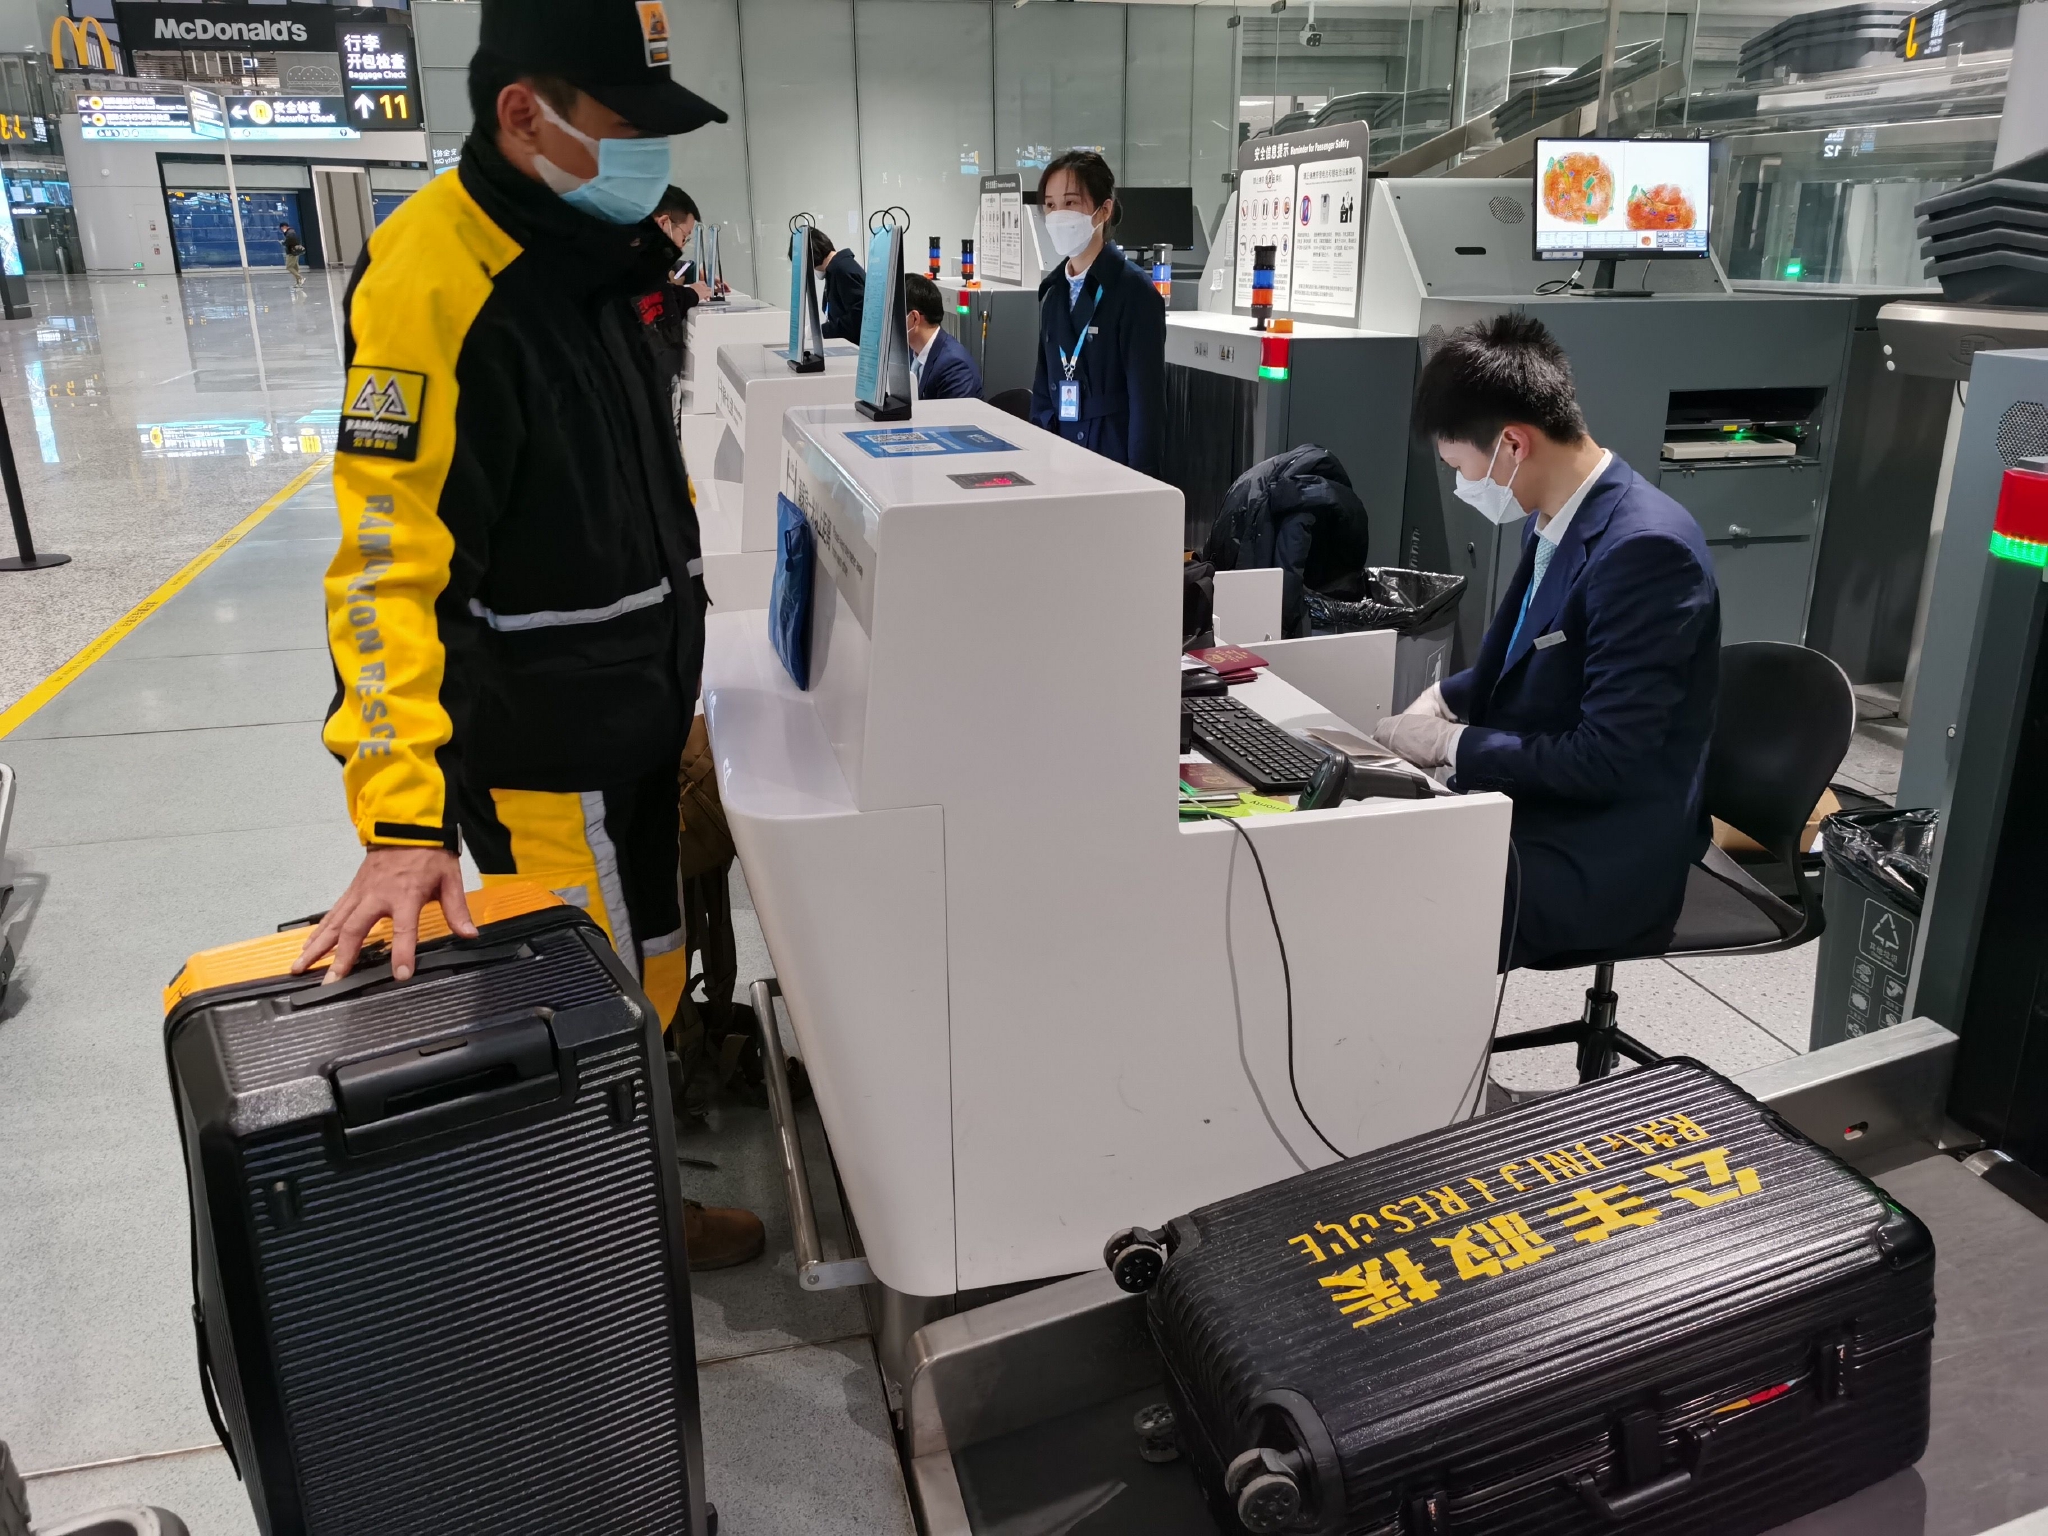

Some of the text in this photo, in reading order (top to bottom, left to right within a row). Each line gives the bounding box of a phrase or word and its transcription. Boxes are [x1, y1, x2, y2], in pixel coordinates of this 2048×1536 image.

[155, 18, 308, 42] McDonald's
[344, 33, 381, 52] 行李
[347, 53, 406, 70] 开包检查
[348, 71, 407, 81] Baggage Check
[273, 101, 321, 114] 安全检查
[379, 94, 408, 119] 11
[274, 114, 336, 124] Security Check
[1253, 143, 1290, 161] 安全信息提示
[1290, 144, 1309, 155] Reminder
[1314, 141, 1336, 152] Passenger
[1335, 138, 1350, 150] Safety
[1318, 1146, 1763, 1329] 公羊救援
